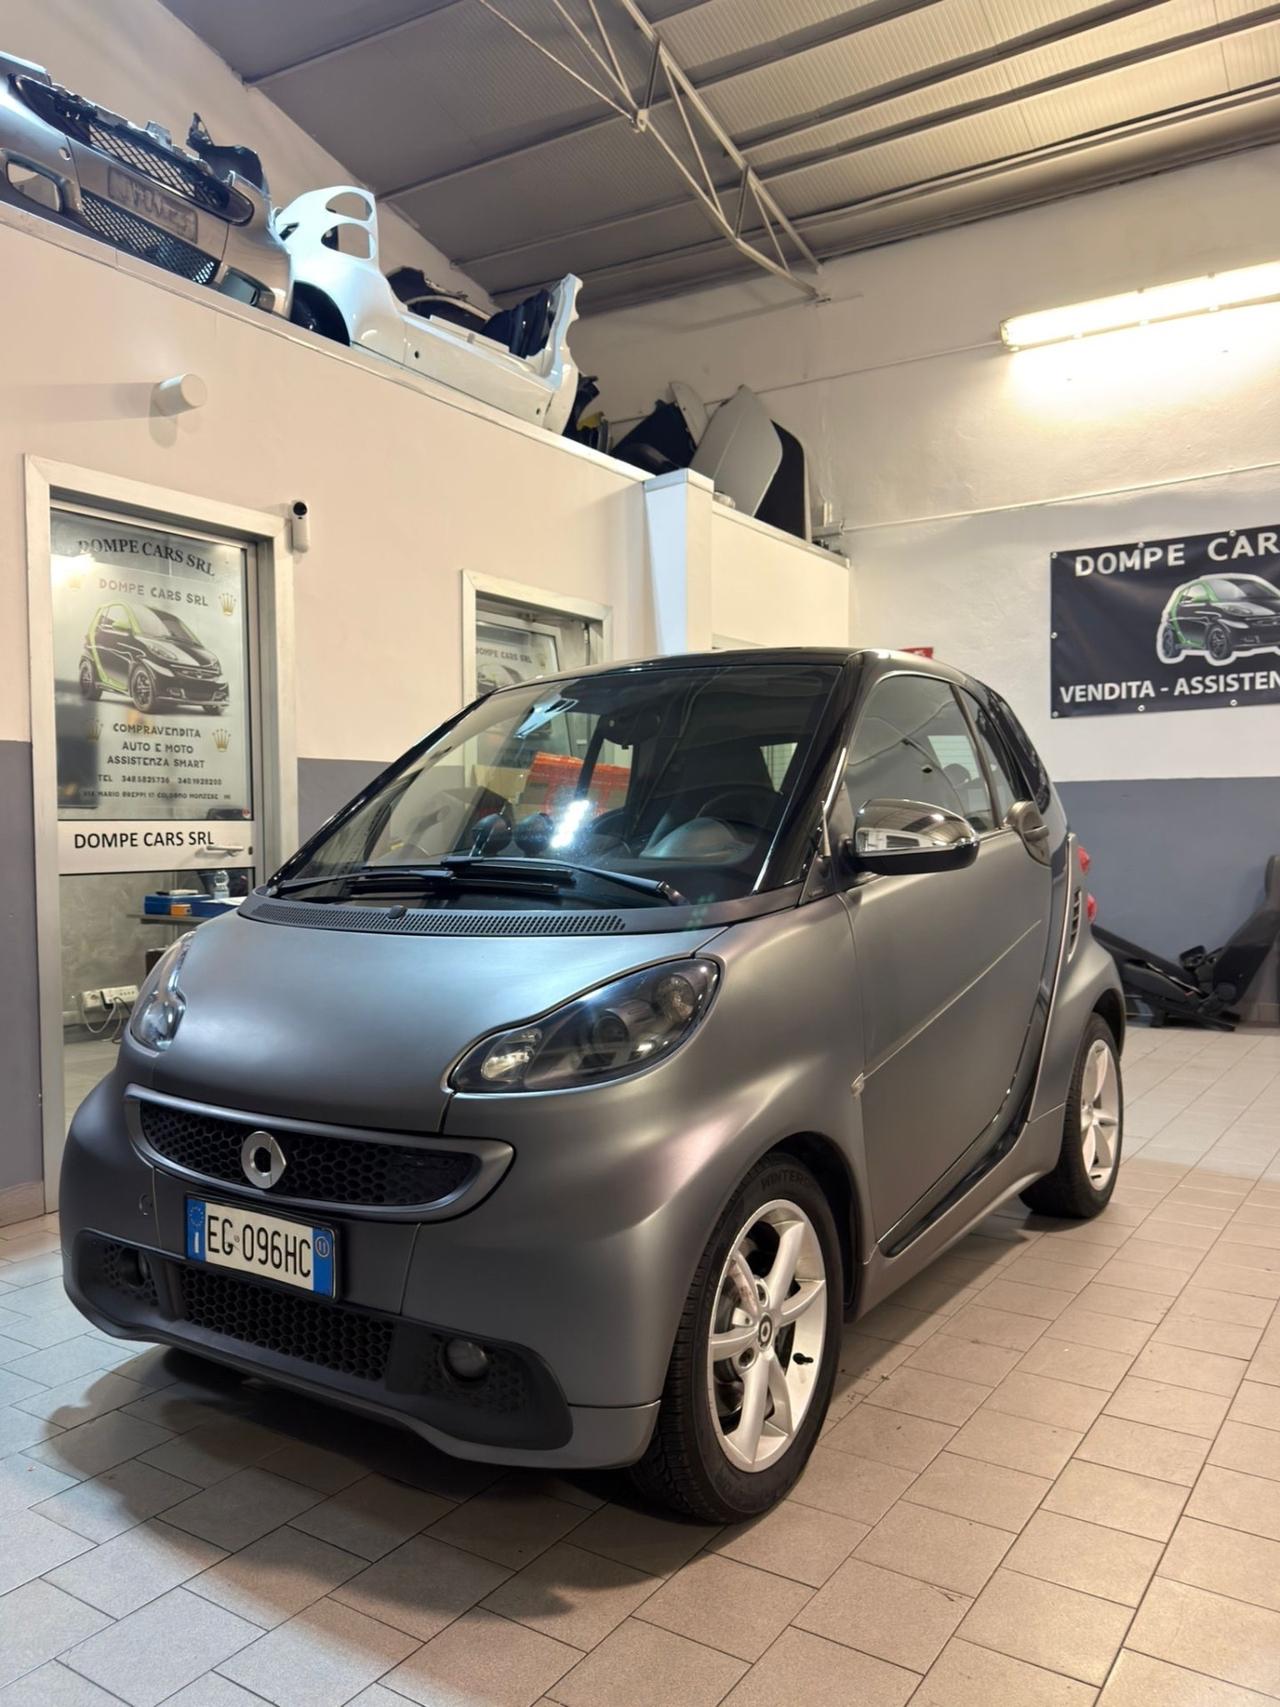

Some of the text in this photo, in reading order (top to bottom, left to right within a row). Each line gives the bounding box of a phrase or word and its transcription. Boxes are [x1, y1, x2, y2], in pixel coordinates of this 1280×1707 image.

[78, 538, 216, 576] DOMPE CARS SRL
[1075, 531, 1280, 577] DOMPE CAR
[99, 578, 209, 607] DOMPE CARS SRL
[1059, 680, 1156, 704] VENDITA
[1173, 671, 1280, 696] ASSISTEN
[121, 741, 194, 754] AUTO E MOTO
[173, 758, 205, 769] SMART
[74, 831, 215, 849] DOMPE CARS SRL
[207, 1215, 234, 1256] EG
[242, 1224, 311, 1278] 096HC
